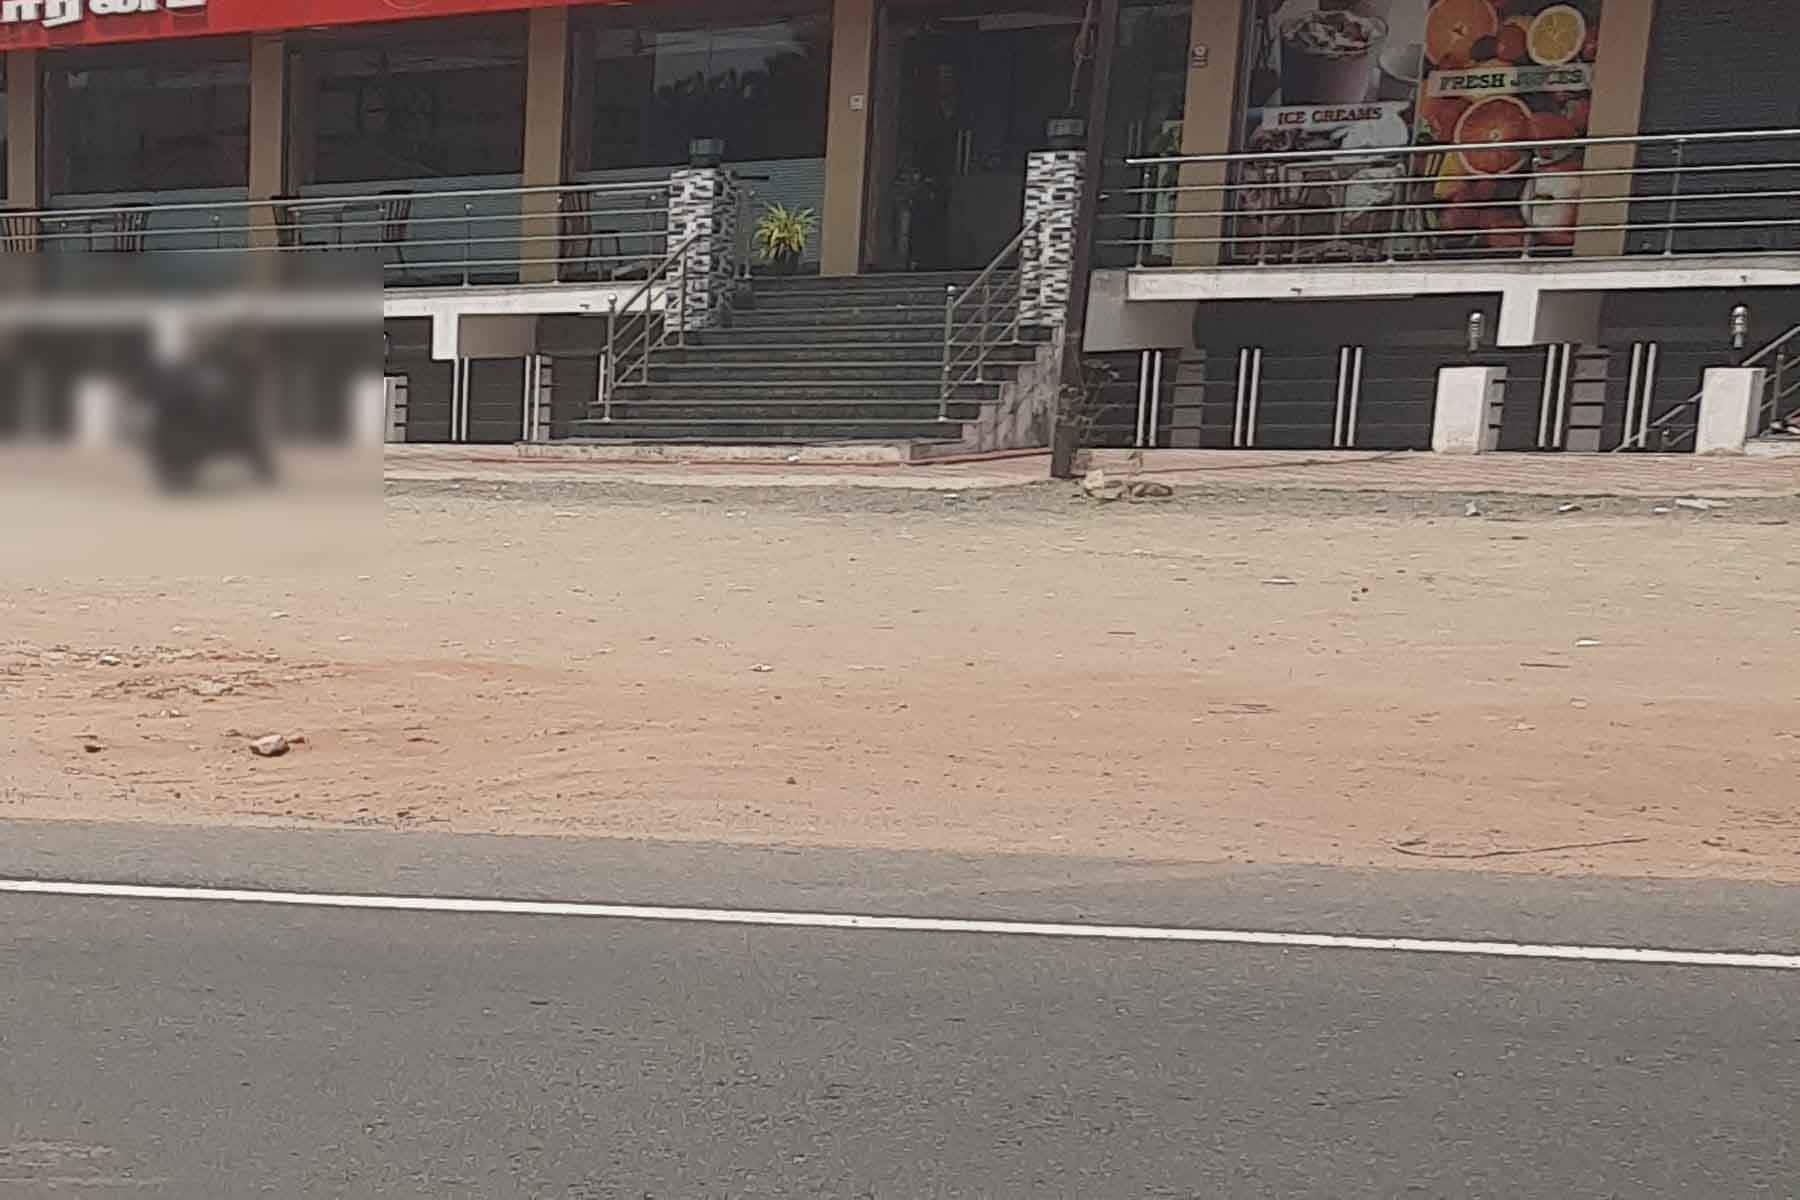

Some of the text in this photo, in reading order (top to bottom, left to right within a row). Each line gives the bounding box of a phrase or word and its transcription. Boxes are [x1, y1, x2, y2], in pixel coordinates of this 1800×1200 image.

[1439, 69, 1584, 91] FRESH JCES
[1278, 107, 1383, 125] ICE CREAMS
